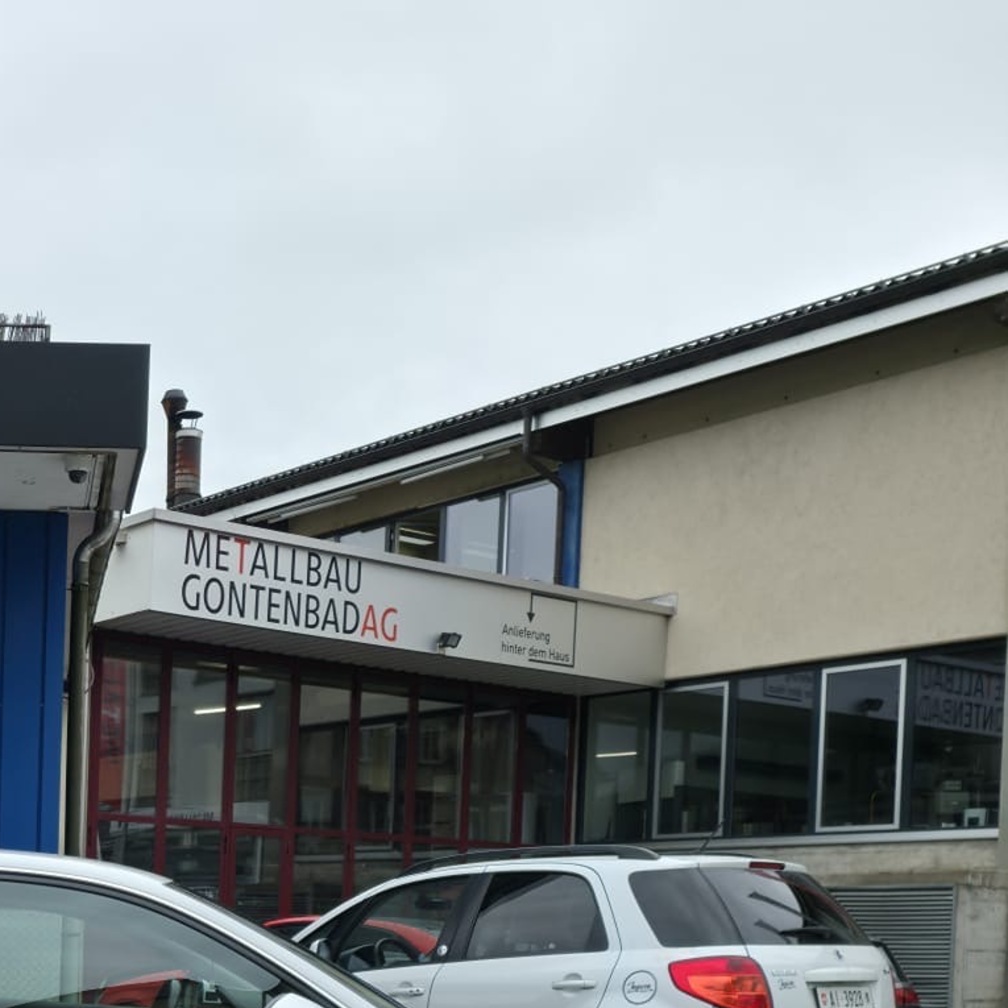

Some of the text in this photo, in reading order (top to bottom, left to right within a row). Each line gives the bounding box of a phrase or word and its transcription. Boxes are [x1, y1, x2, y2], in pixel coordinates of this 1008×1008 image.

[183, 528, 363, 594] METALLBAU
[501, 623, 551, 645] Anlieferung
[501, 641, 571, 663] hinter dem Haus
